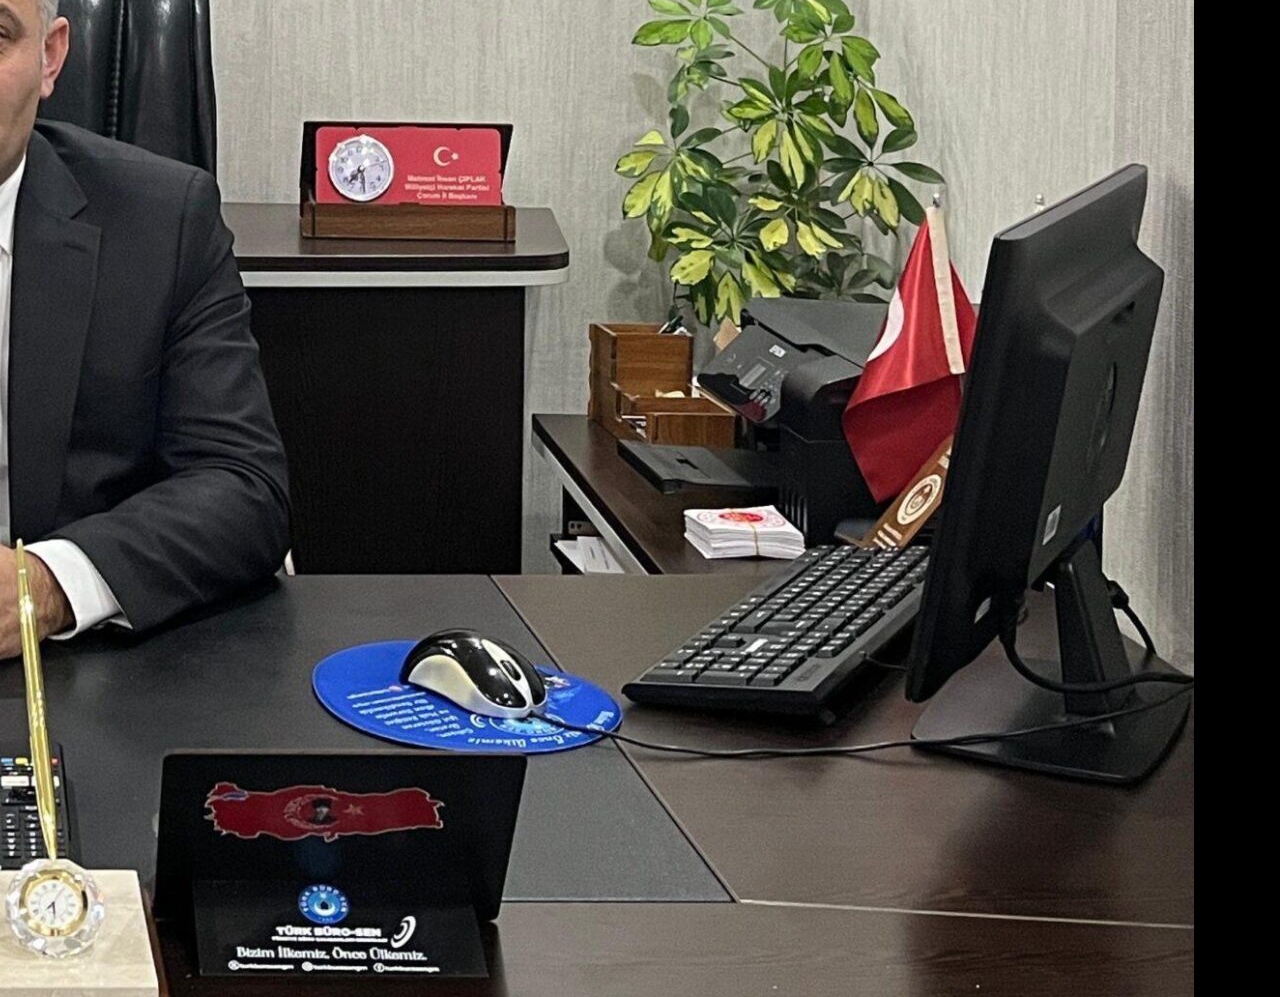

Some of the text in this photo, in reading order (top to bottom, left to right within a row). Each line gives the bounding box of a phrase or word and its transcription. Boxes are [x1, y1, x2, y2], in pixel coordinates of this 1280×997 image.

[276, 925, 382, 937] TÜRK BÜRO-SEN
[236, 946, 275, 959] Bizim
[332, 946, 367, 960] Önce
